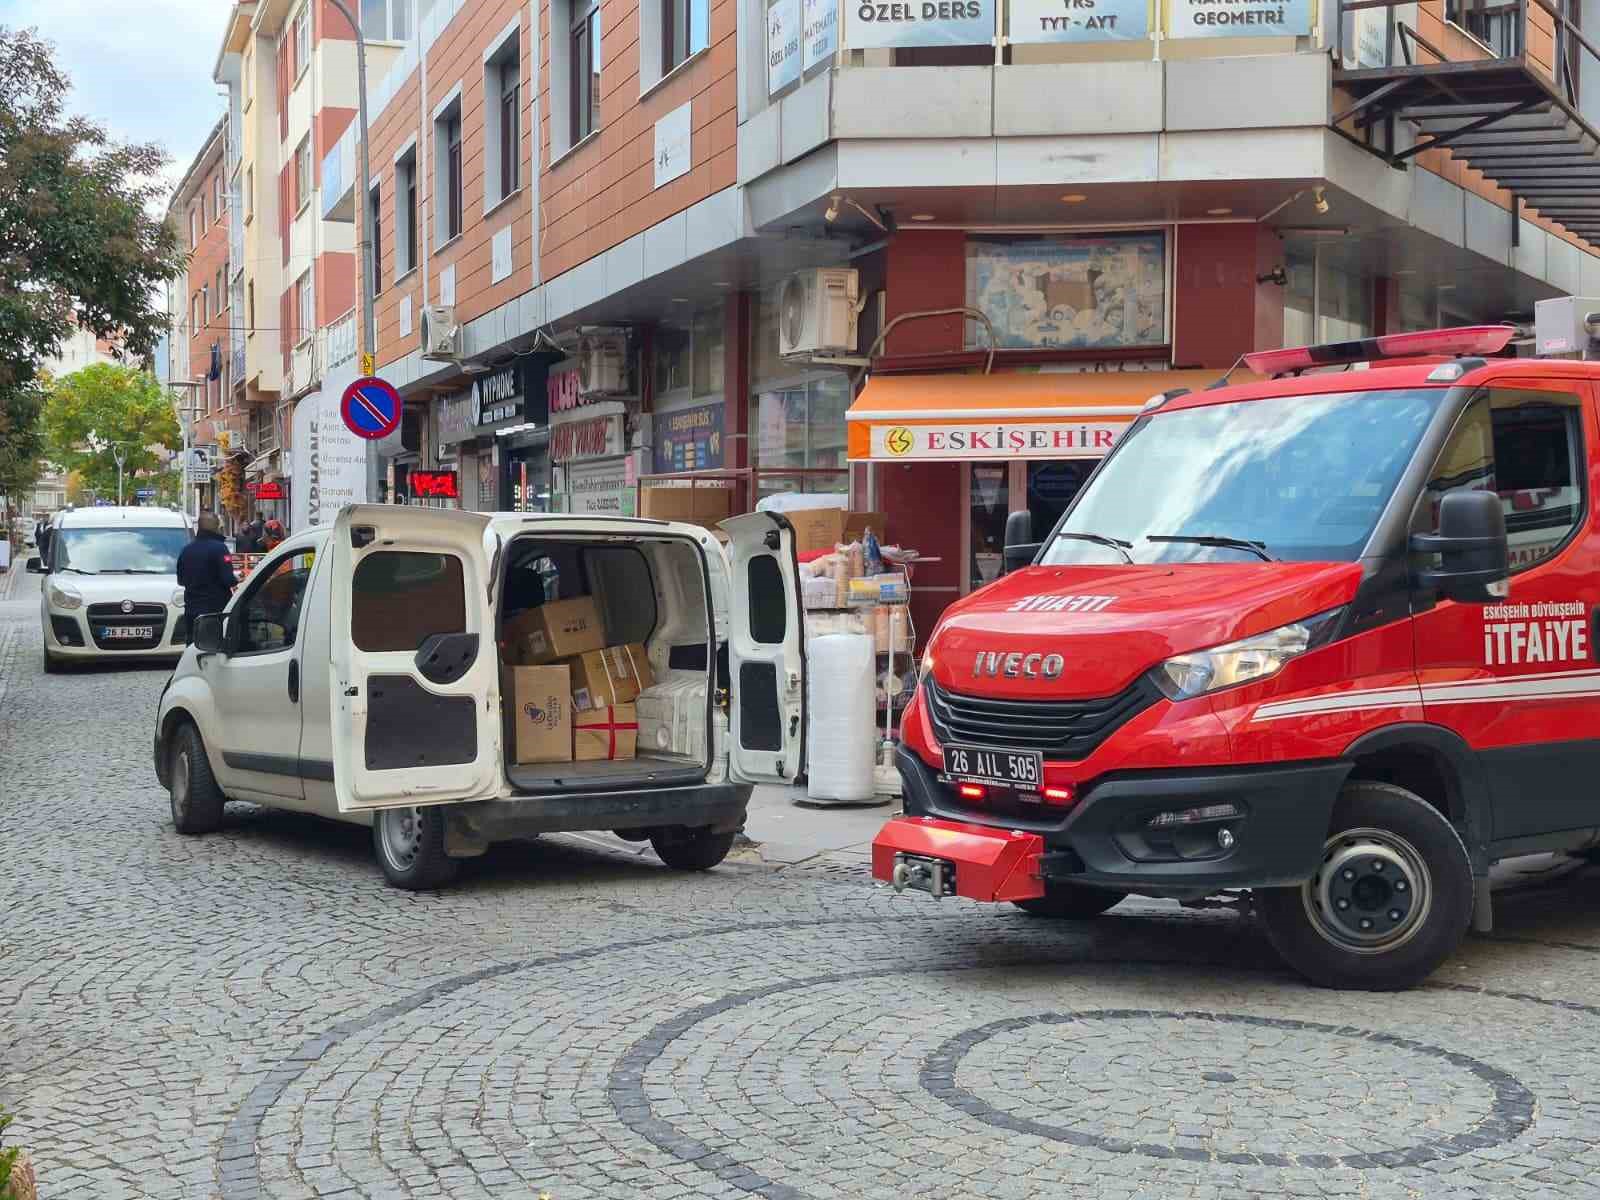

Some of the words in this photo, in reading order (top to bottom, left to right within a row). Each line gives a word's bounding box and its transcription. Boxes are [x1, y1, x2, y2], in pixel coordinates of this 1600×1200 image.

[858, 0, 914, 22] ÖZEL
[921, 2, 981, 20] DERS
[1039, 16, 1071, 31] TYT
[1085, 15, 1118, 30] AYT
[1193, 6, 1285, 26] GEOMETRİ
[927, 426, 1114, 453] ESKİŞEHİR
[1483, 603, 1529, 621] ESKİŞEHİR
[1531, 600, 1585, 619] BÜYÜKŞEHİR
[1484, 620, 1588, 665] İTFAİYE
[973, 651, 1065, 679] IVECO
[951, 750, 969, 773] 26
[977, 754, 1002, 777] AIL
[1008, 756, 1036, 780] 505
